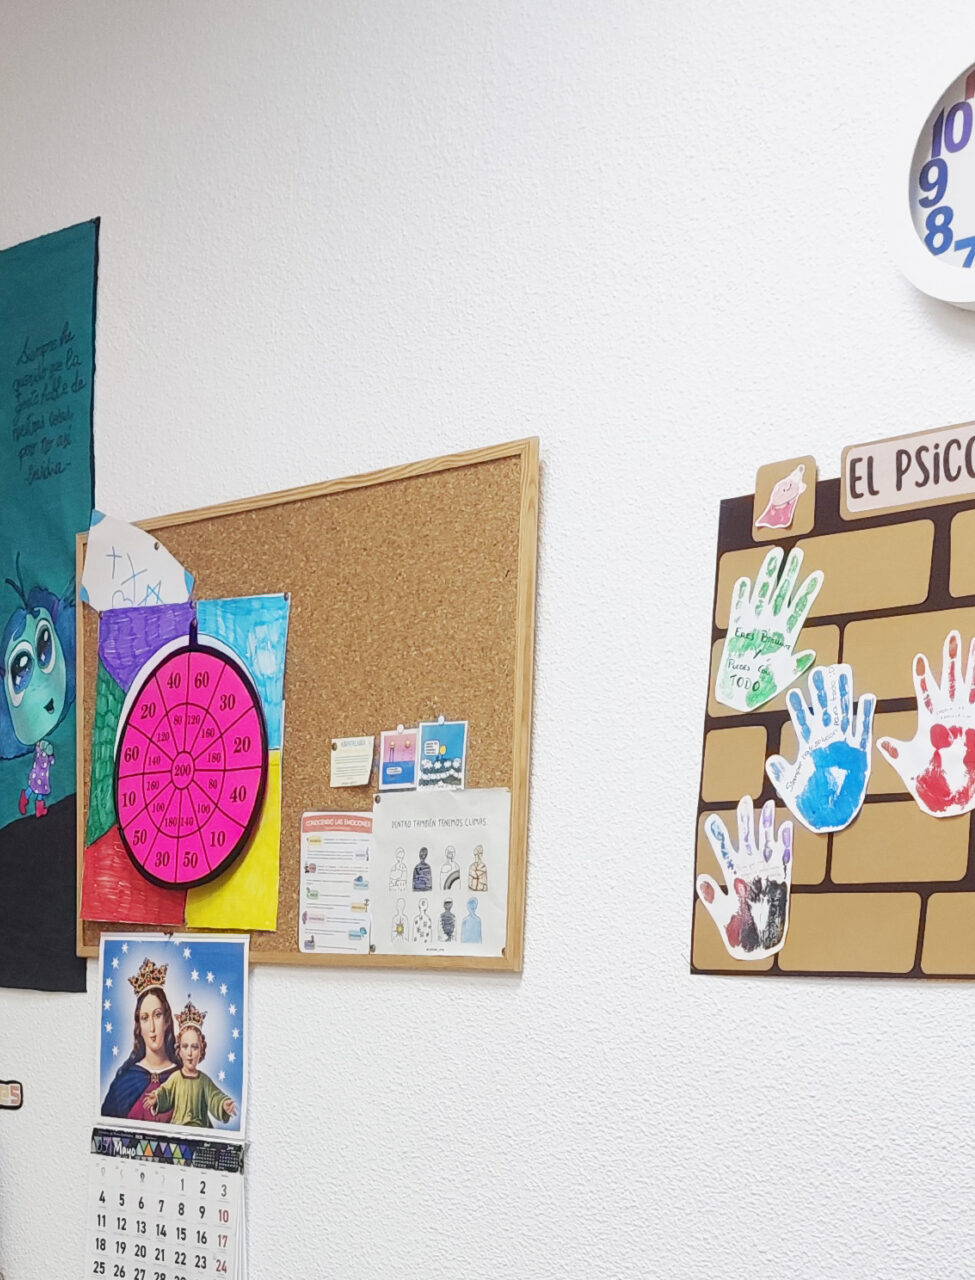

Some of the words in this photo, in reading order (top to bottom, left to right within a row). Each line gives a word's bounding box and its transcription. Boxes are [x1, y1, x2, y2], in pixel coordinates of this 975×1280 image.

[931, 100, 973, 159] 10
[919, 157, 948, 208] 9
[924, 205, 954, 256] 8
[849, 456, 880, 499] EL
[167, 672, 181, 689] 40
[194, 671, 210, 689] 60
[140, 702, 156, 719] 20
[219, 694, 236, 711] 30
[233, 736, 251, 754] 20
[124, 746, 139, 762] 60
[174, 764, 191, 777] 200
[122, 791, 136, 808] 10
[229, 785, 246, 803] 40
[132, 829, 147, 846] 50
[210, 831, 226, 847] 10
[155, 851, 170, 867] 30
[183, 851, 198, 868] 50
[180, 1178, 184, 1191] 1
[200, 1181, 206, 1194] 2
[221, 1184, 227, 1197] 3
[99, 1190, 105, 1203] 4
[119, 1194, 125, 1206] 5
[138, 1196, 144, 1209] 6
[158, 1200, 164, 1212] 7
[178, 1203, 184, 1215] 8
[199, 1206, 205, 1219] 9
[219, 1209, 229, 1223] 10
[97, 1214, 106, 1227] 11
[117, 1217, 127, 1231] 12
[136, 1220, 146, 1234] 13
[155, 1224, 167, 1237] 14
[176, 1227, 187, 1241] 15
[196, 1231, 207, 1244] 16
[218, 1234, 228, 1248] 17
[95, 1238, 106, 1251] 18
[115, 1241, 126, 1254] 19
[134, 1244, 147, 1258] 20
[154, 1248, 165, 1261] 21
[174, 1251, 186, 1265] 22
[194, 1255, 207, 1269] 23
[216, 1260, 227, 1273] 24
[93, 1261, 105, 1275] 25
[113, 1265, 126, 1278] 26
